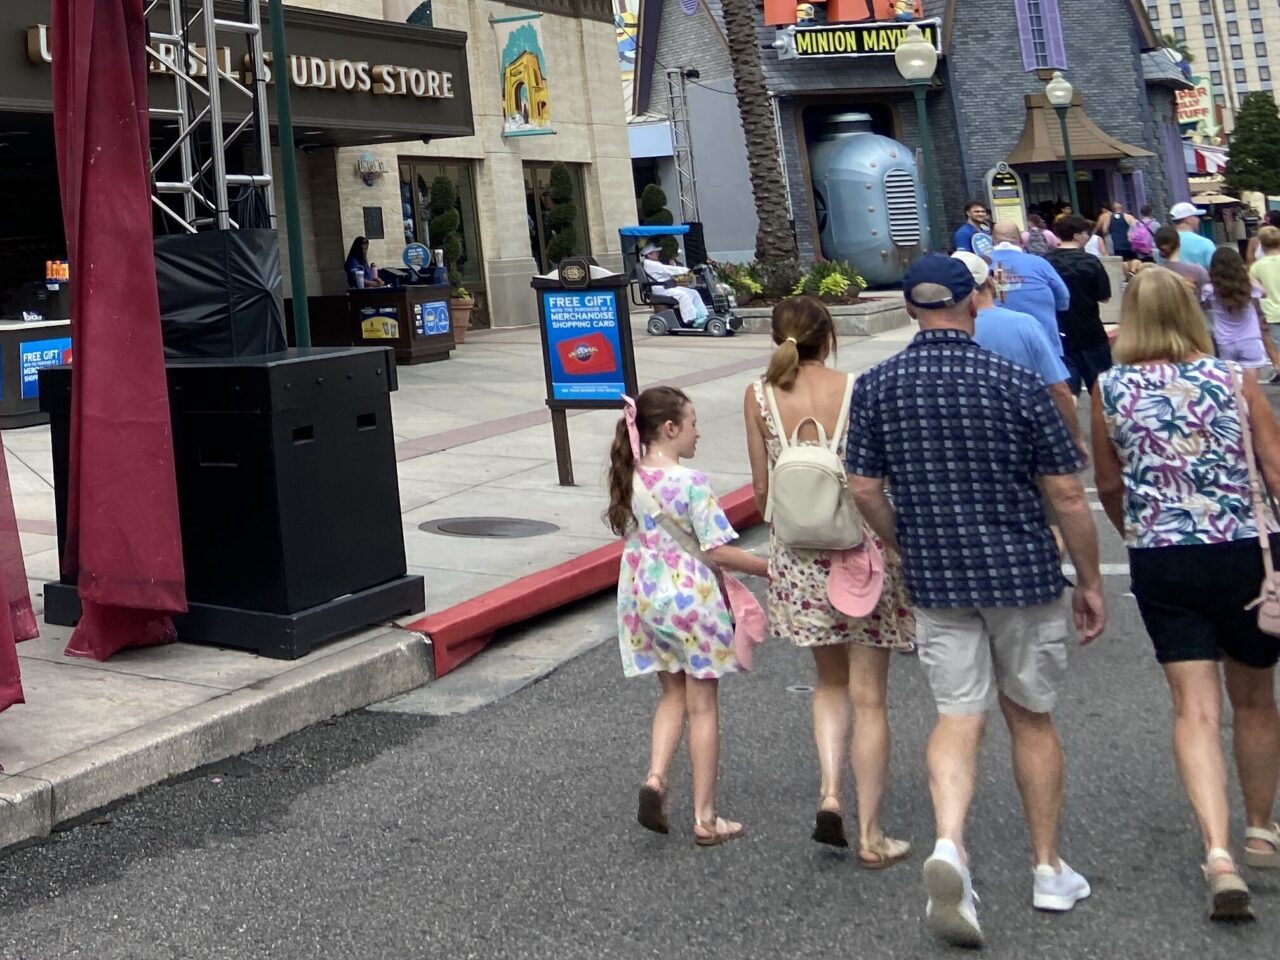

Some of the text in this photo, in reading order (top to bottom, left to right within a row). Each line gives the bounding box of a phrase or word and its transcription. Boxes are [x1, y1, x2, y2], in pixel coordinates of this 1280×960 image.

[796, 27, 933, 54] MINION MAYHM
[244, 51, 372, 92] SUDIOS
[373, 64, 455, 99] STORE
[1179, 87, 1207, 100] PER
[1178, 108, 1208, 119] TUFF
[549, 295, 612, 308] FREE GIFT
[551, 311, 614, 321] MERCHANDISE
[552, 320, 615, 329] SHOPPING CARD
[23, 350, 58, 362] FREE GIFT
